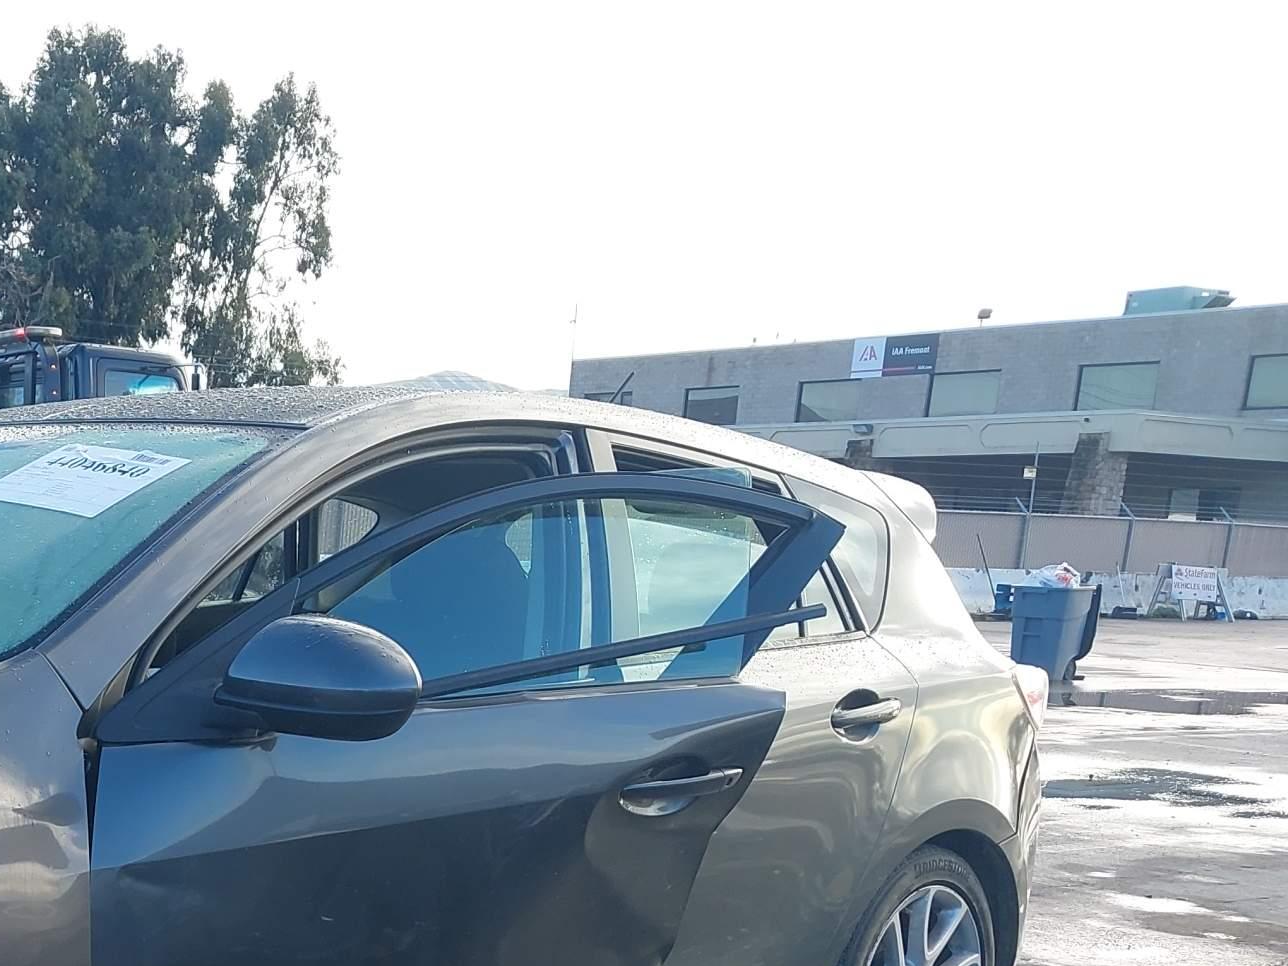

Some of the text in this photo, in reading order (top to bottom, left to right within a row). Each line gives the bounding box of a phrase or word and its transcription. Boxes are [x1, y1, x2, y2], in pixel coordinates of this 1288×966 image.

[892, 347, 904, 356] IAA
[46, 456, 151, 478] 44046840
[1174, 582, 1216, 592] VEHICLES ONLY
